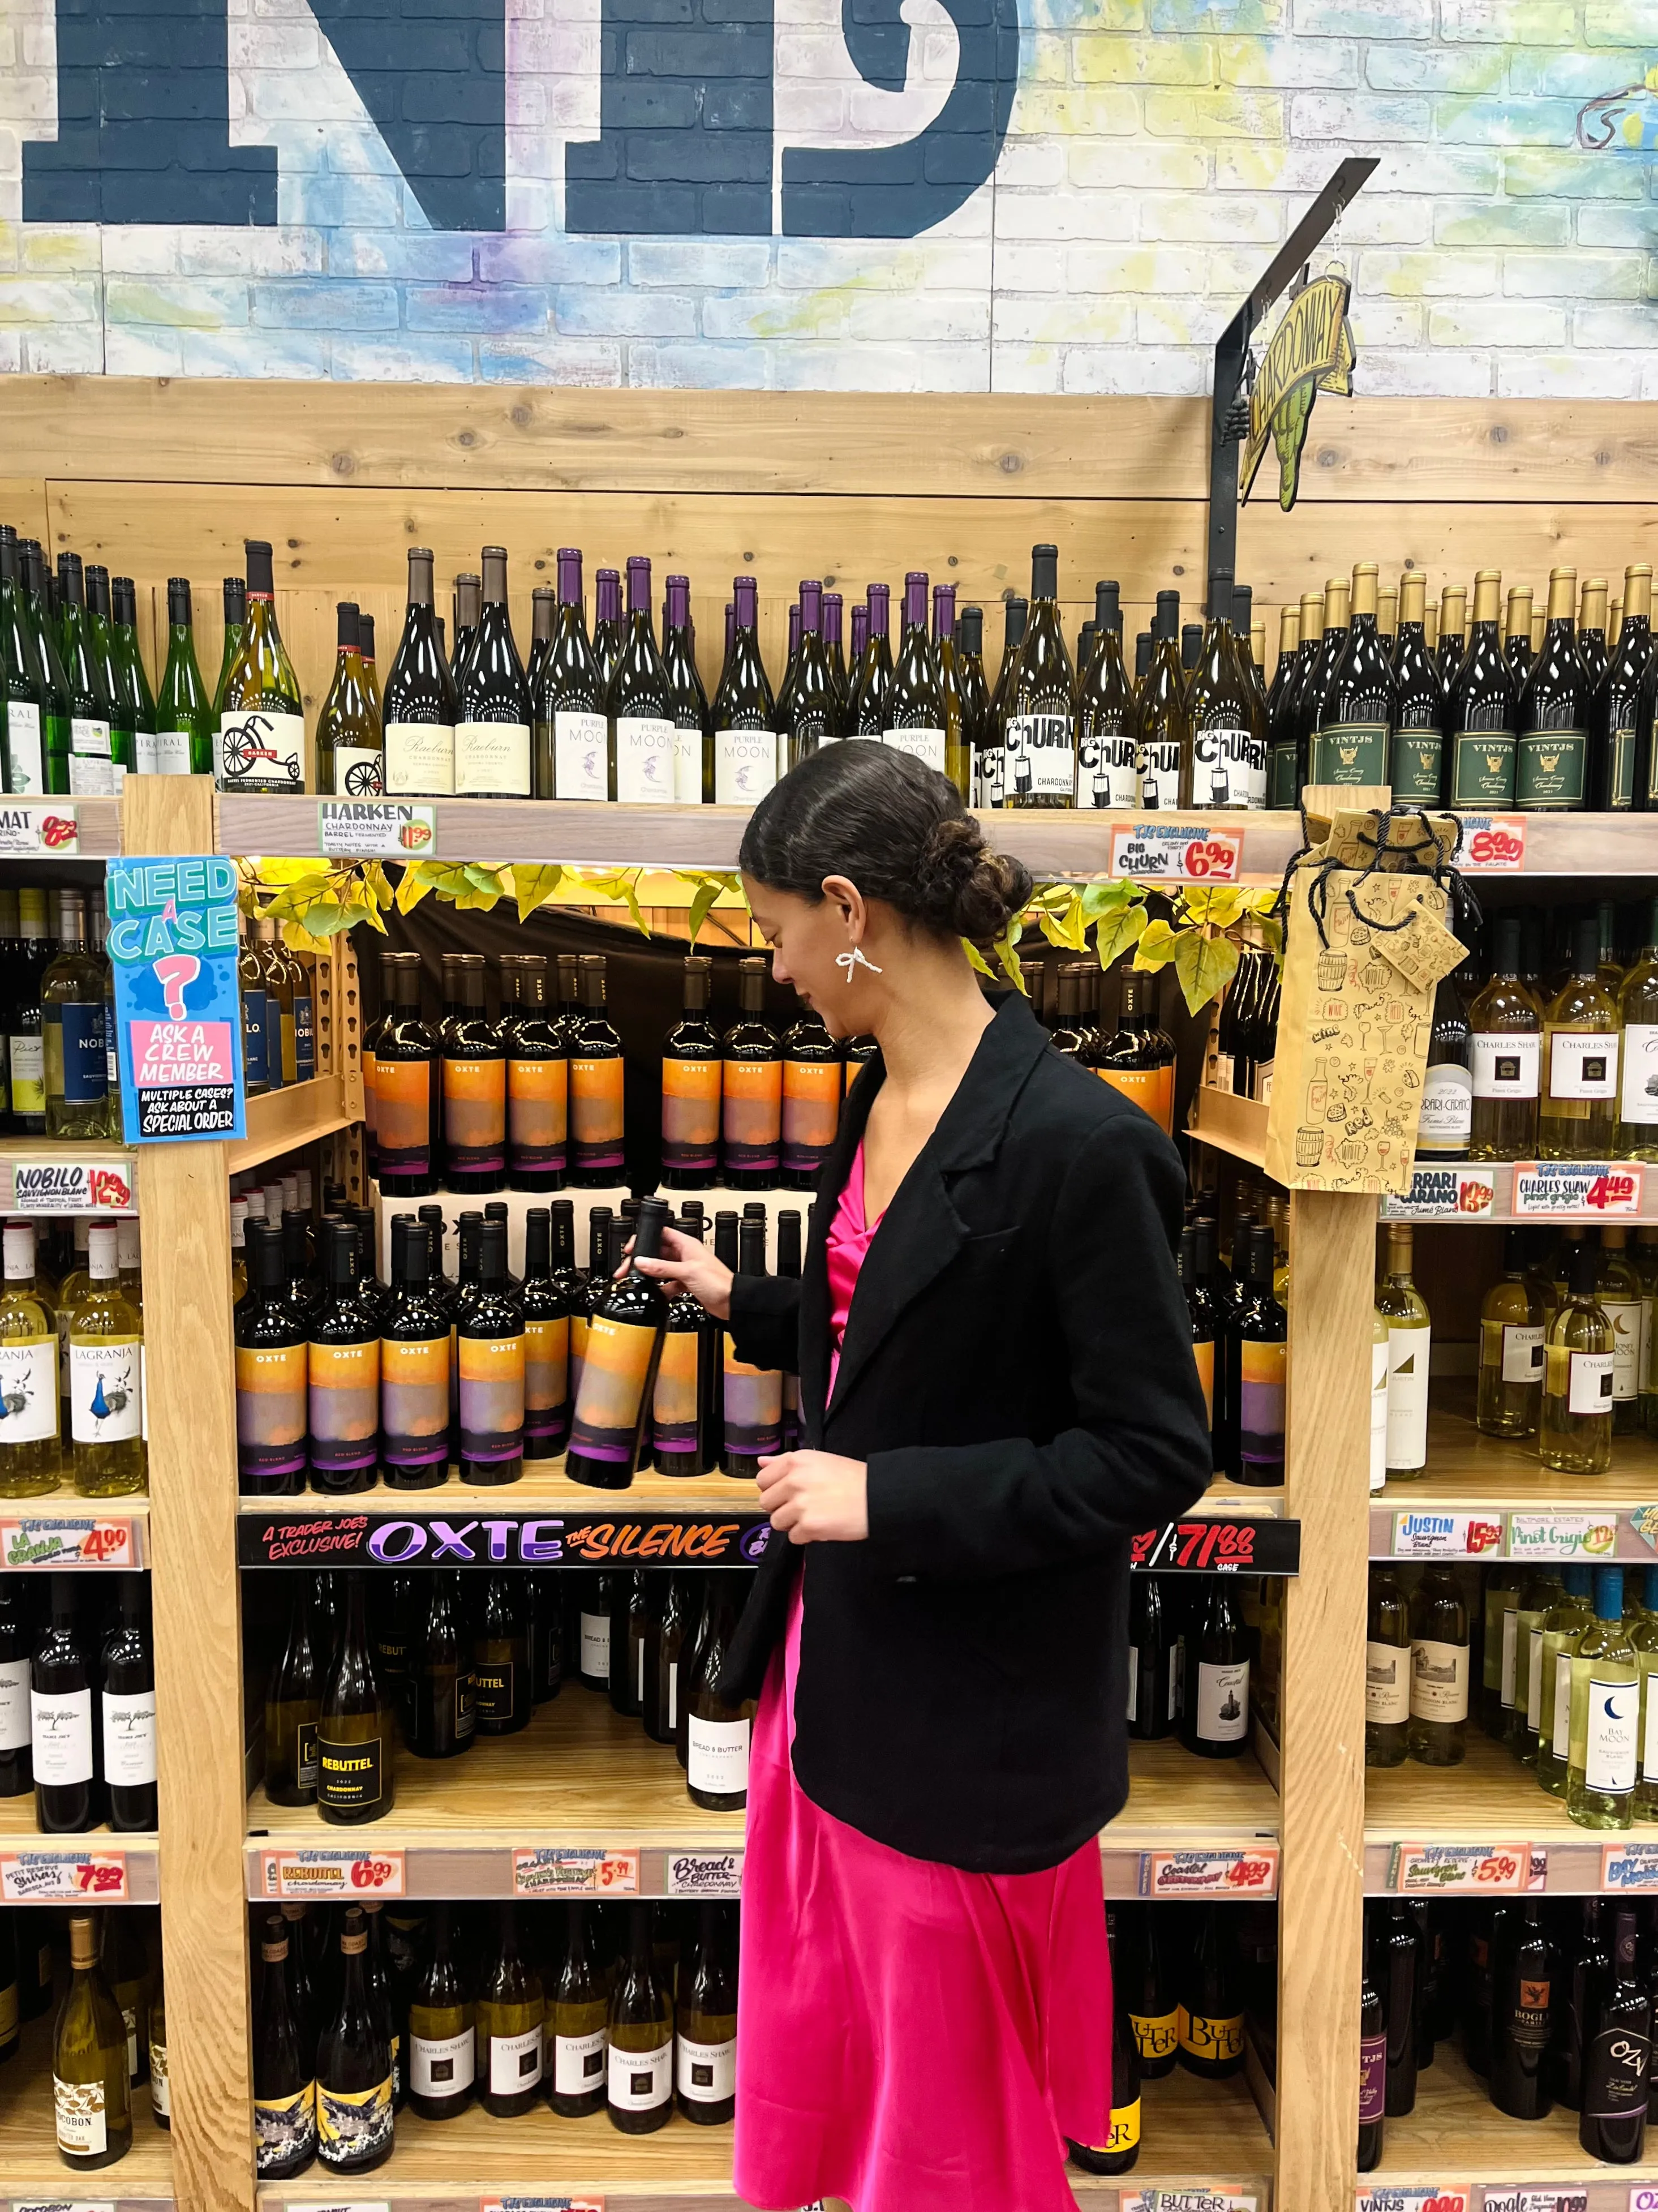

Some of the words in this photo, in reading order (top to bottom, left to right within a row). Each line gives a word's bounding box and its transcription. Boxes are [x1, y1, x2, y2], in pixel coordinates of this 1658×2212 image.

[581, 719, 604, 728] PURPLE
[641, 724, 668, 733] PURPLE
[403, 736, 453, 756] Raeburn
[462, 735, 511, 752] Raeburn
[1329, 736, 1373, 745] VINTJS
[1528, 744, 1574, 752] VINTJS
[724, 746, 770, 758] MOON
[1473, 744, 1513, 753] VINTJS
[322, 803, 413, 820] HARKEN
[326, 822, 393, 831] CHARDONNAY
[1156, 826, 1210, 841] EXCLUSIVE
[1128, 843, 1145, 854] BIG
[1119, 852, 1169, 869] CHURN
[113, 859, 237, 909] NEED
[162, 899, 177, 924] A
[111, 904, 238, 959] CASE
[150, 1024, 188, 1043] ASK
[191, 1025, 205, 1043] A
[1477, 1040, 1515, 1049] CHARLES
[1562, 1040, 1603, 1049] CHARLES
[145, 1044, 214, 1062] CREW
[139, 1062, 224, 1083] MEMBER
[377, 1065, 395, 1074] OXTE
[141, 1090, 192, 1102] MULTIPLE
[194, 1088, 234, 1100] CASES?
[147, 1102, 169, 1113] ASK
[170, 1100, 207, 1112] ABOUT
[209, 1101, 217, 1110] A
[143, 1113, 192, 1133] SPECIAL
[194, 1111, 233, 1129] ORDER
[16, 1167, 83, 1189] NOBILO
[1520, 1179, 1561, 1194] CHARLES
[1563, 1180, 1591, 1194] SHAW
[1524, 1193, 1550, 1204] pinot
[1550, 1193, 1579, 1205] grigio
[333, 1349, 363, 1359] OXTE
[400, 1347, 429, 1355] OXTE
[491, 1343, 517, 1353] OXTE
[256, 1354, 286, 1364] OXTE
[262, 1526, 274, 1544] A
[277, 1520, 333, 1540] TRADER
[1403, 1514, 1454, 1536] JUSTIN
[12, 1532, 31, 1550] LA
[367, 1520, 565, 1563] OXTE
[566, 1525, 592, 1547] THE
[580, 1523, 740, 1558] SILENCE
[1512, 1527, 1547, 1544] Pinot
[1549, 1527, 1592, 1555] Grigio
[269, 1532, 363, 1561] EXCLUSIVE!
[1599, 1734, 1630, 1743] MOON
[693, 1741, 710, 1752] BREAD
[323, 1756, 373, 1771] REBUTTEL
[283, 1866, 345, 1880] REBUTTEL
[673, 1856, 728, 1880] Bread
[1162, 1863, 1208, 1876] Coastal
[1608, 1858, 1639, 1882] BAY
[14, 1871, 62, 1888] Shiraz
[287, 1880, 347, 1890] chardonnay
[415, 2043, 449, 2055] CHARLES
[680, 2041, 708, 2058] CHARLES
[615, 2055, 648, 2066] CHARLES
